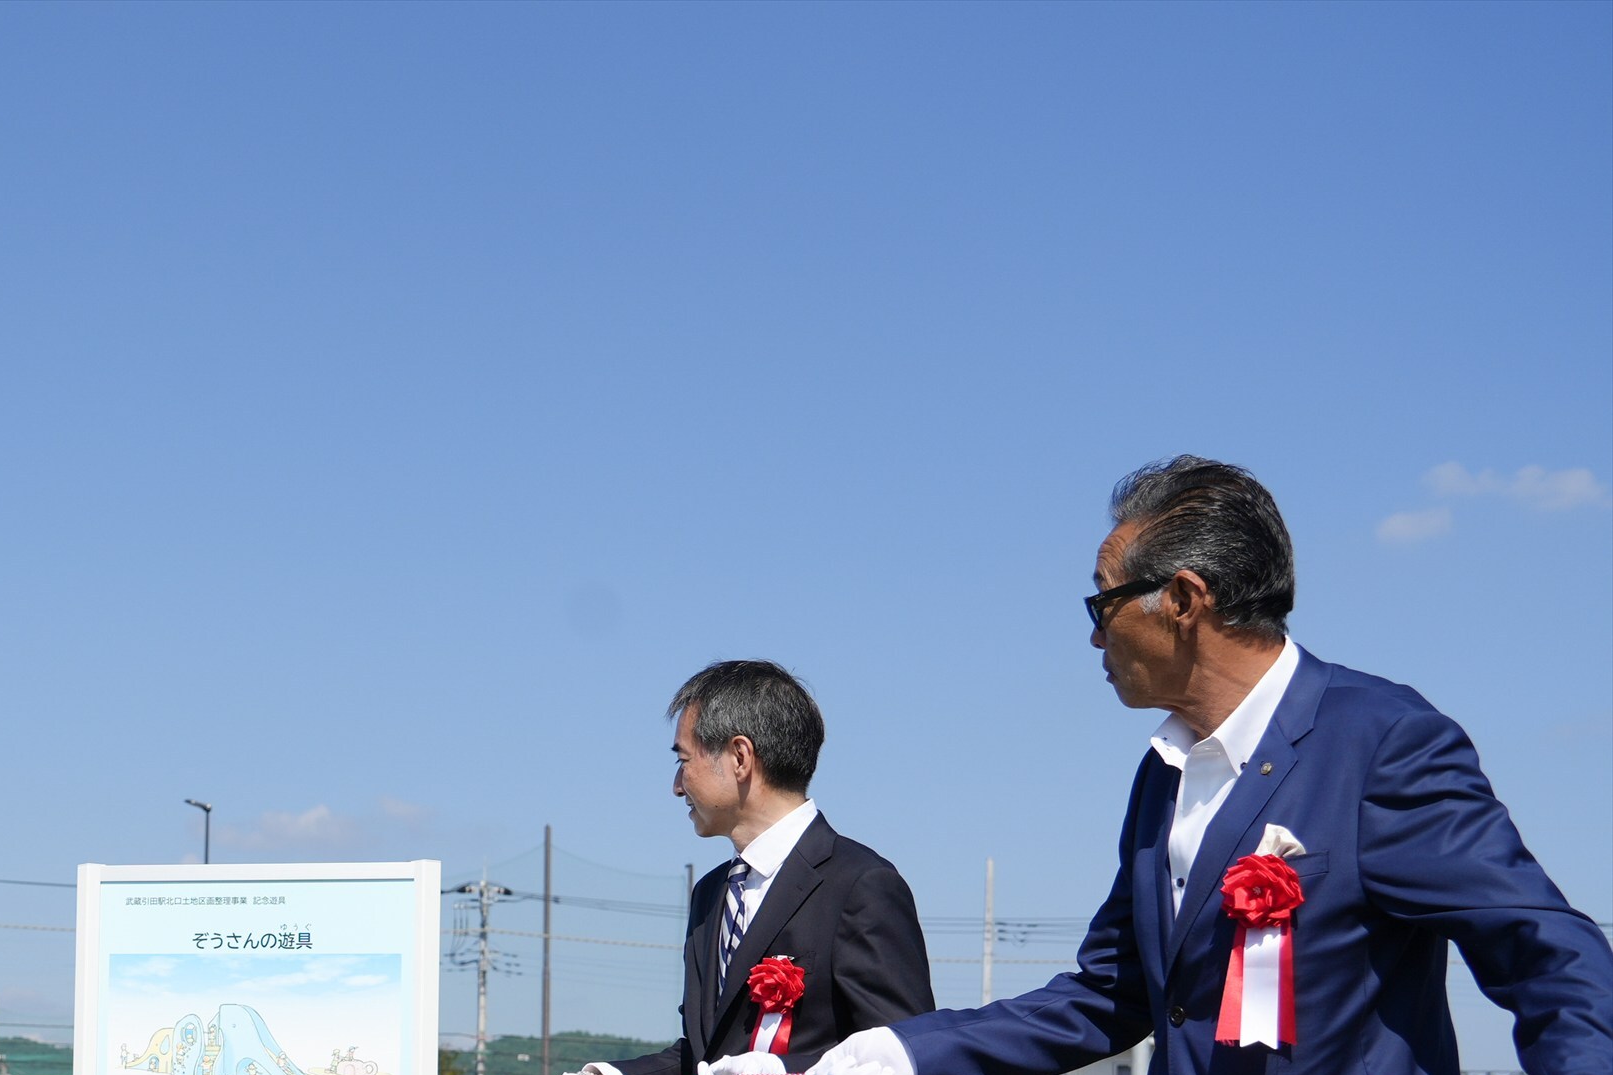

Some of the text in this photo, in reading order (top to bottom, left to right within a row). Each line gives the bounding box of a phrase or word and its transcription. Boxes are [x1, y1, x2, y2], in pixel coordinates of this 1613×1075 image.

[252, 896, 286, 905] 記念遊具
[192, 931, 313, 950] ぞうさんの遊具
